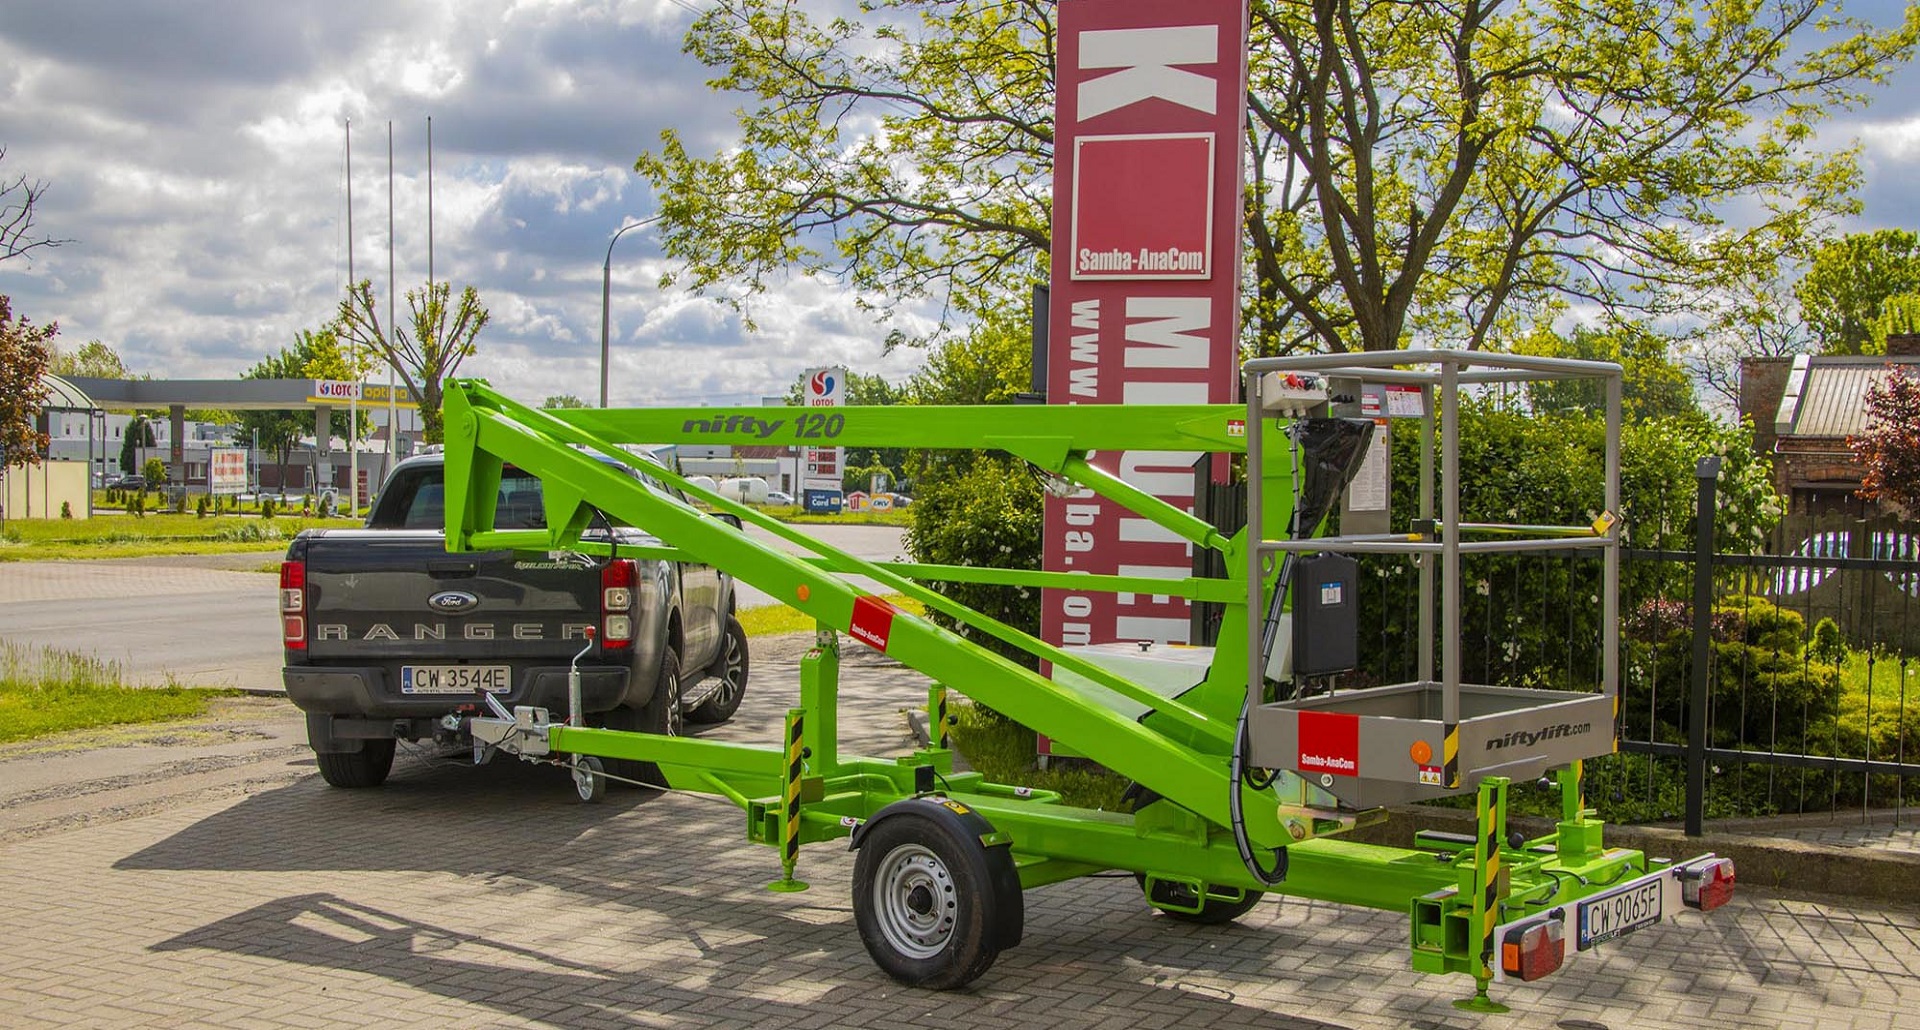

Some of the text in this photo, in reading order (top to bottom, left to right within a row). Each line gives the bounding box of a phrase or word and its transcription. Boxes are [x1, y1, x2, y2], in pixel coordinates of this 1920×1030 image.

[1079, 247, 1203, 272] Samba-AnaCom
[681, 413, 845, 438] nifty 120
[441, 596, 462, 606] Ford
[317, 623, 590, 640] RANGER
[415, 669, 440, 688] CW
[447, 669, 505, 688] 3544E
[1485, 722, 1592, 752] niftylift.com
[1301, 753, 1355, 770] Samba-AnaCom
[1591, 884, 1657, 936] CW 9065F
